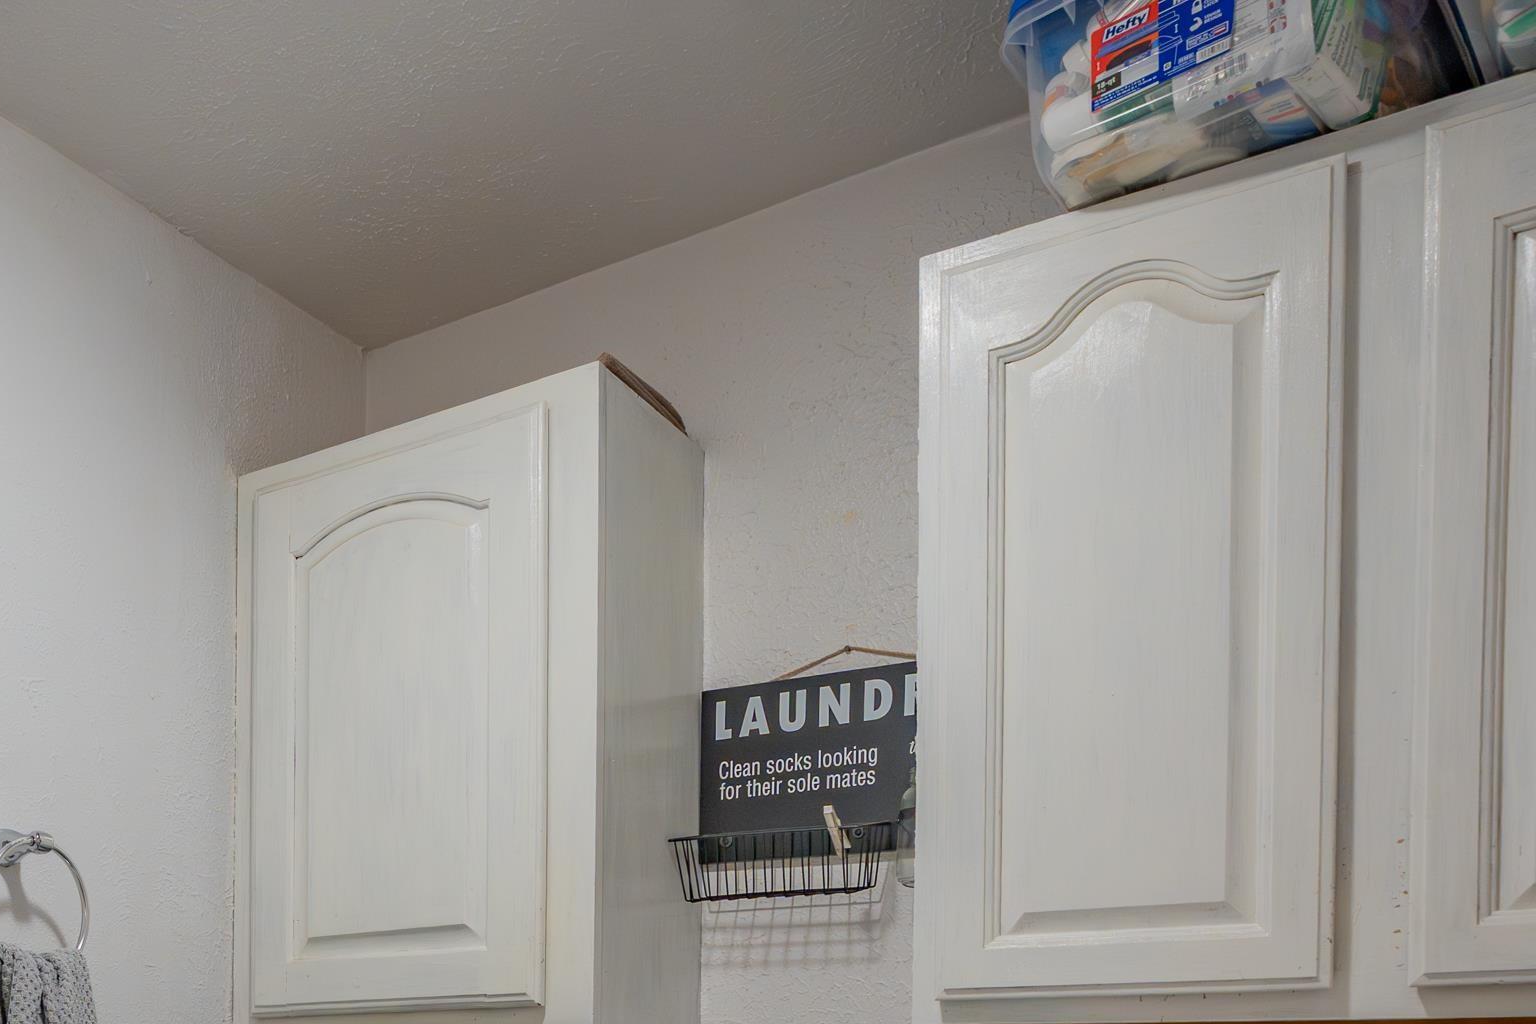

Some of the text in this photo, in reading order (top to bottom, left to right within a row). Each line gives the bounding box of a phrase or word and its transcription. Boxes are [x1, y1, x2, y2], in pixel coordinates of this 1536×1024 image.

[1104, 12, 1148, 40] Hefty
[719, 745, 878, 780] Clean socks looking
[719, 768, 876, 801] for their sole mates
